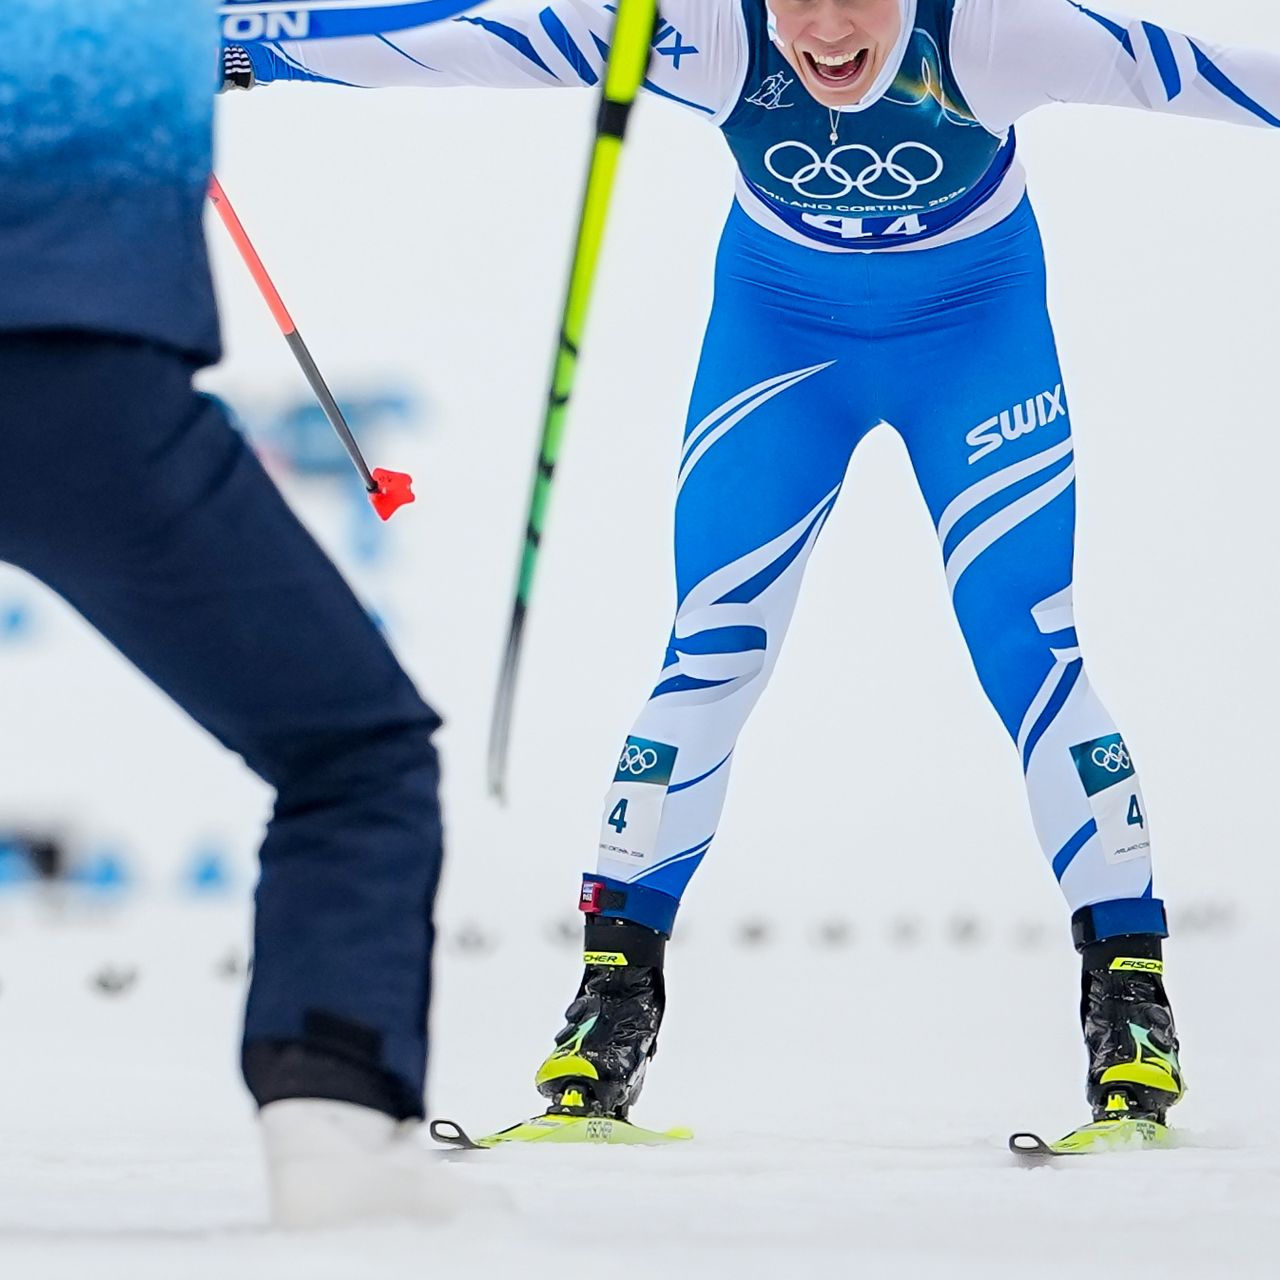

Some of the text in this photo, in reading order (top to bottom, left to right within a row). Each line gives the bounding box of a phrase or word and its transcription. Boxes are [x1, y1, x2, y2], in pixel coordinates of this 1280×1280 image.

[754, 182, 832, 211] MILANO
[965, 384, 1066, 465] SWIX
[607, 798, 629, 834] 4
[1126, 794, 1144, 830] 4
